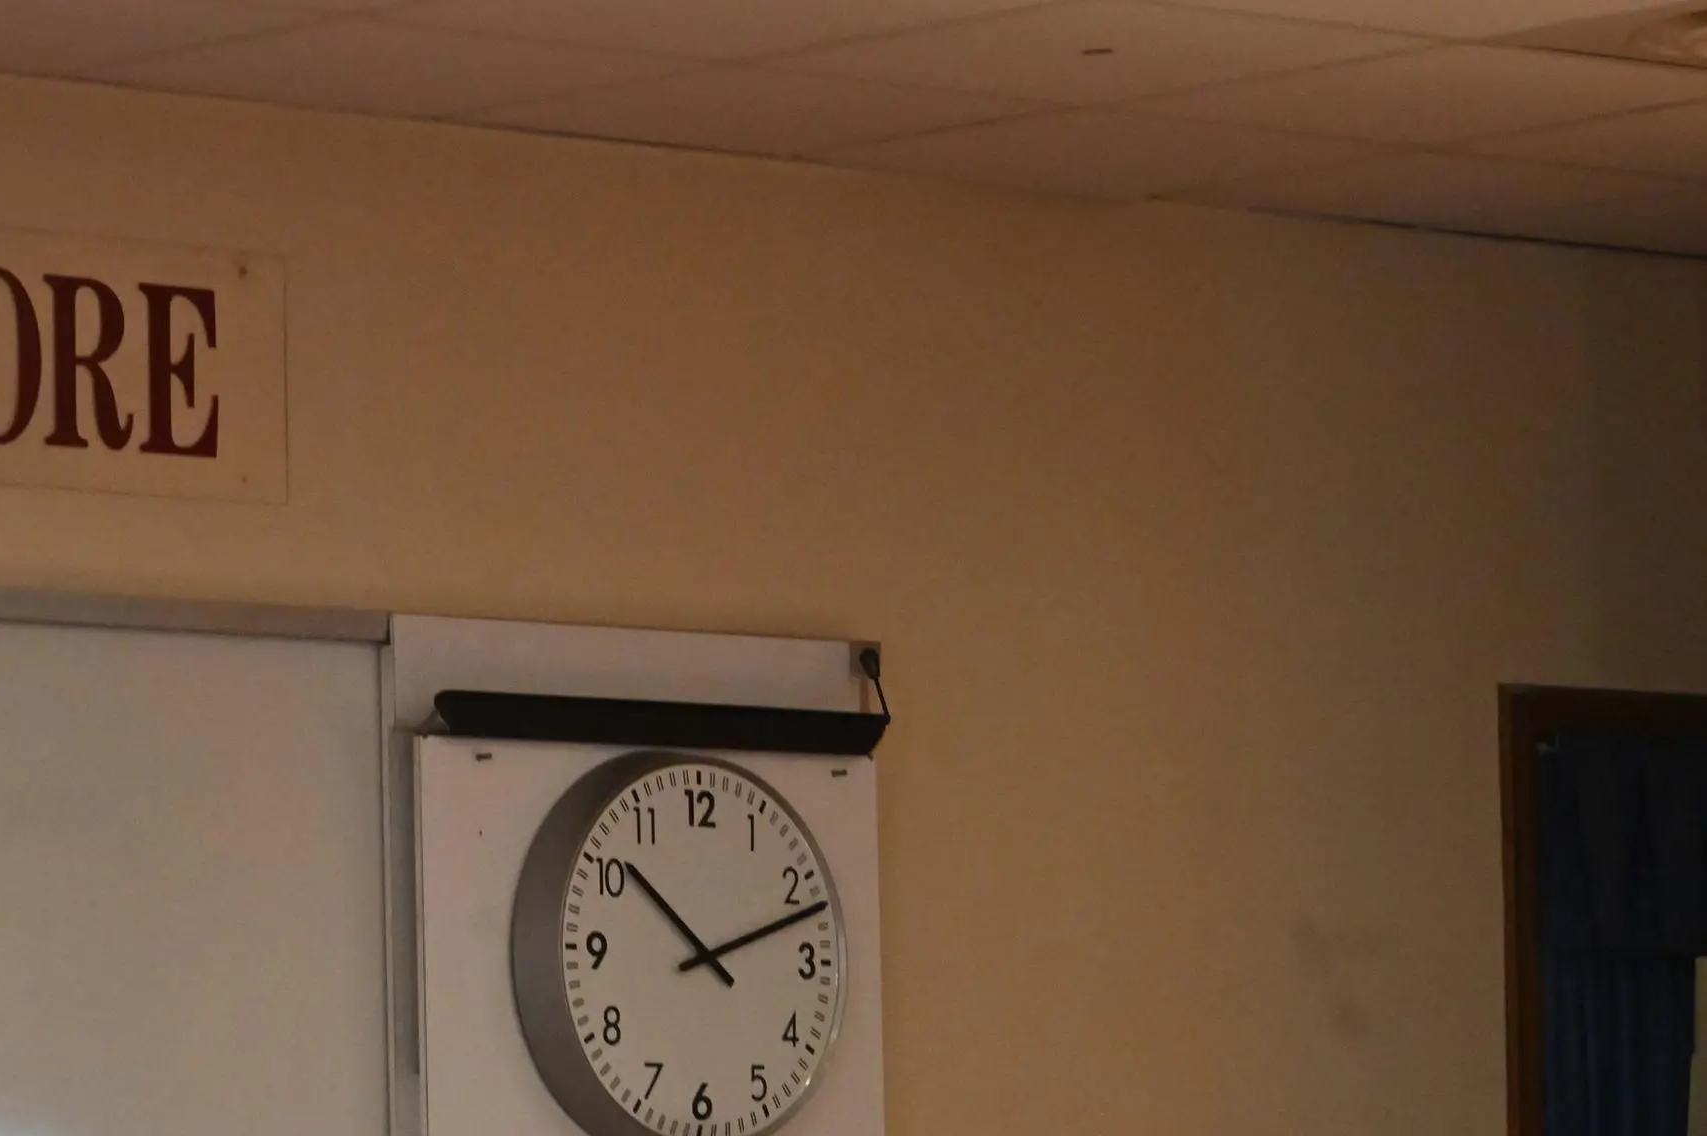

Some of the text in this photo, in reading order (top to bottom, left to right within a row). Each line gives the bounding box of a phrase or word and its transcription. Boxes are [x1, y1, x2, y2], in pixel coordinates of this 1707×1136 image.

[633, 806, 656, 845] 11
[684, 788, 717, 829] 12
[747, 813, 756, 852] 1
[596, 857, 626, 898] 10
[782, 866, 800, 905] 2
[586, 931, 608, 970] 9
[797, 942, 817, 980] 3
[602, 1005, 622, 1045] 8
[781, 1012, 800, 1047] 4
[644, 1062, 664, 1100] 7
[750, 1064, 768, 1102] 5
[692, 1082, 713, 1120] 6
